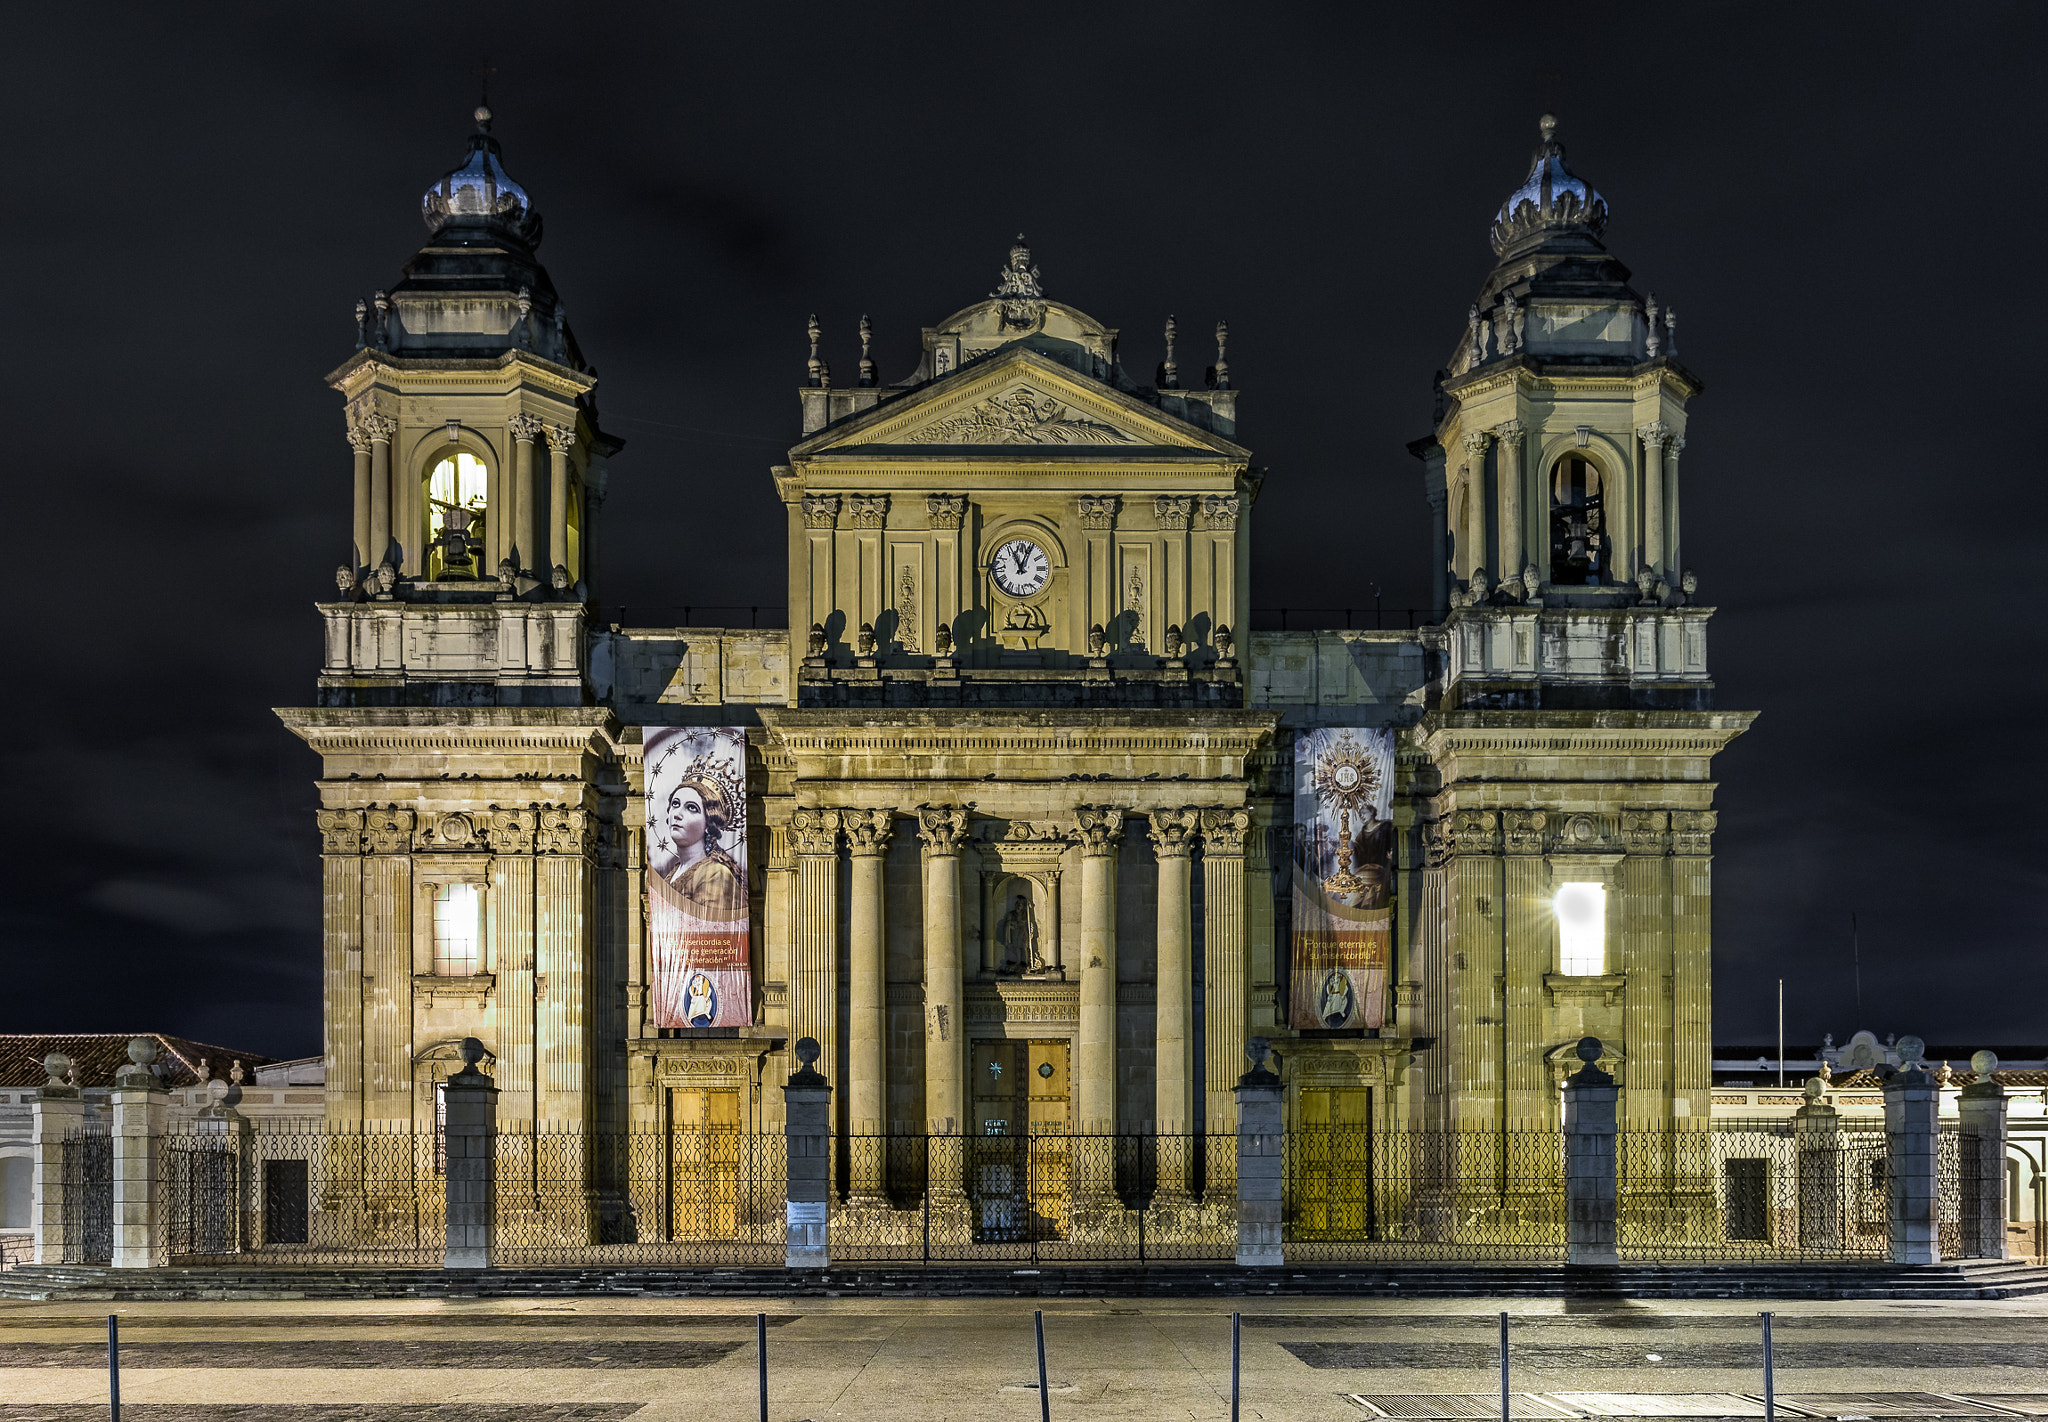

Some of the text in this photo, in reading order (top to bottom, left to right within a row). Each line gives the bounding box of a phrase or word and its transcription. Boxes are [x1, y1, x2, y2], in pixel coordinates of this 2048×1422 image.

[683, 938, 722, 946] sericordia
[1338, 941, 1366, 949] eterna
[1367, 941, 1377, 949] es
